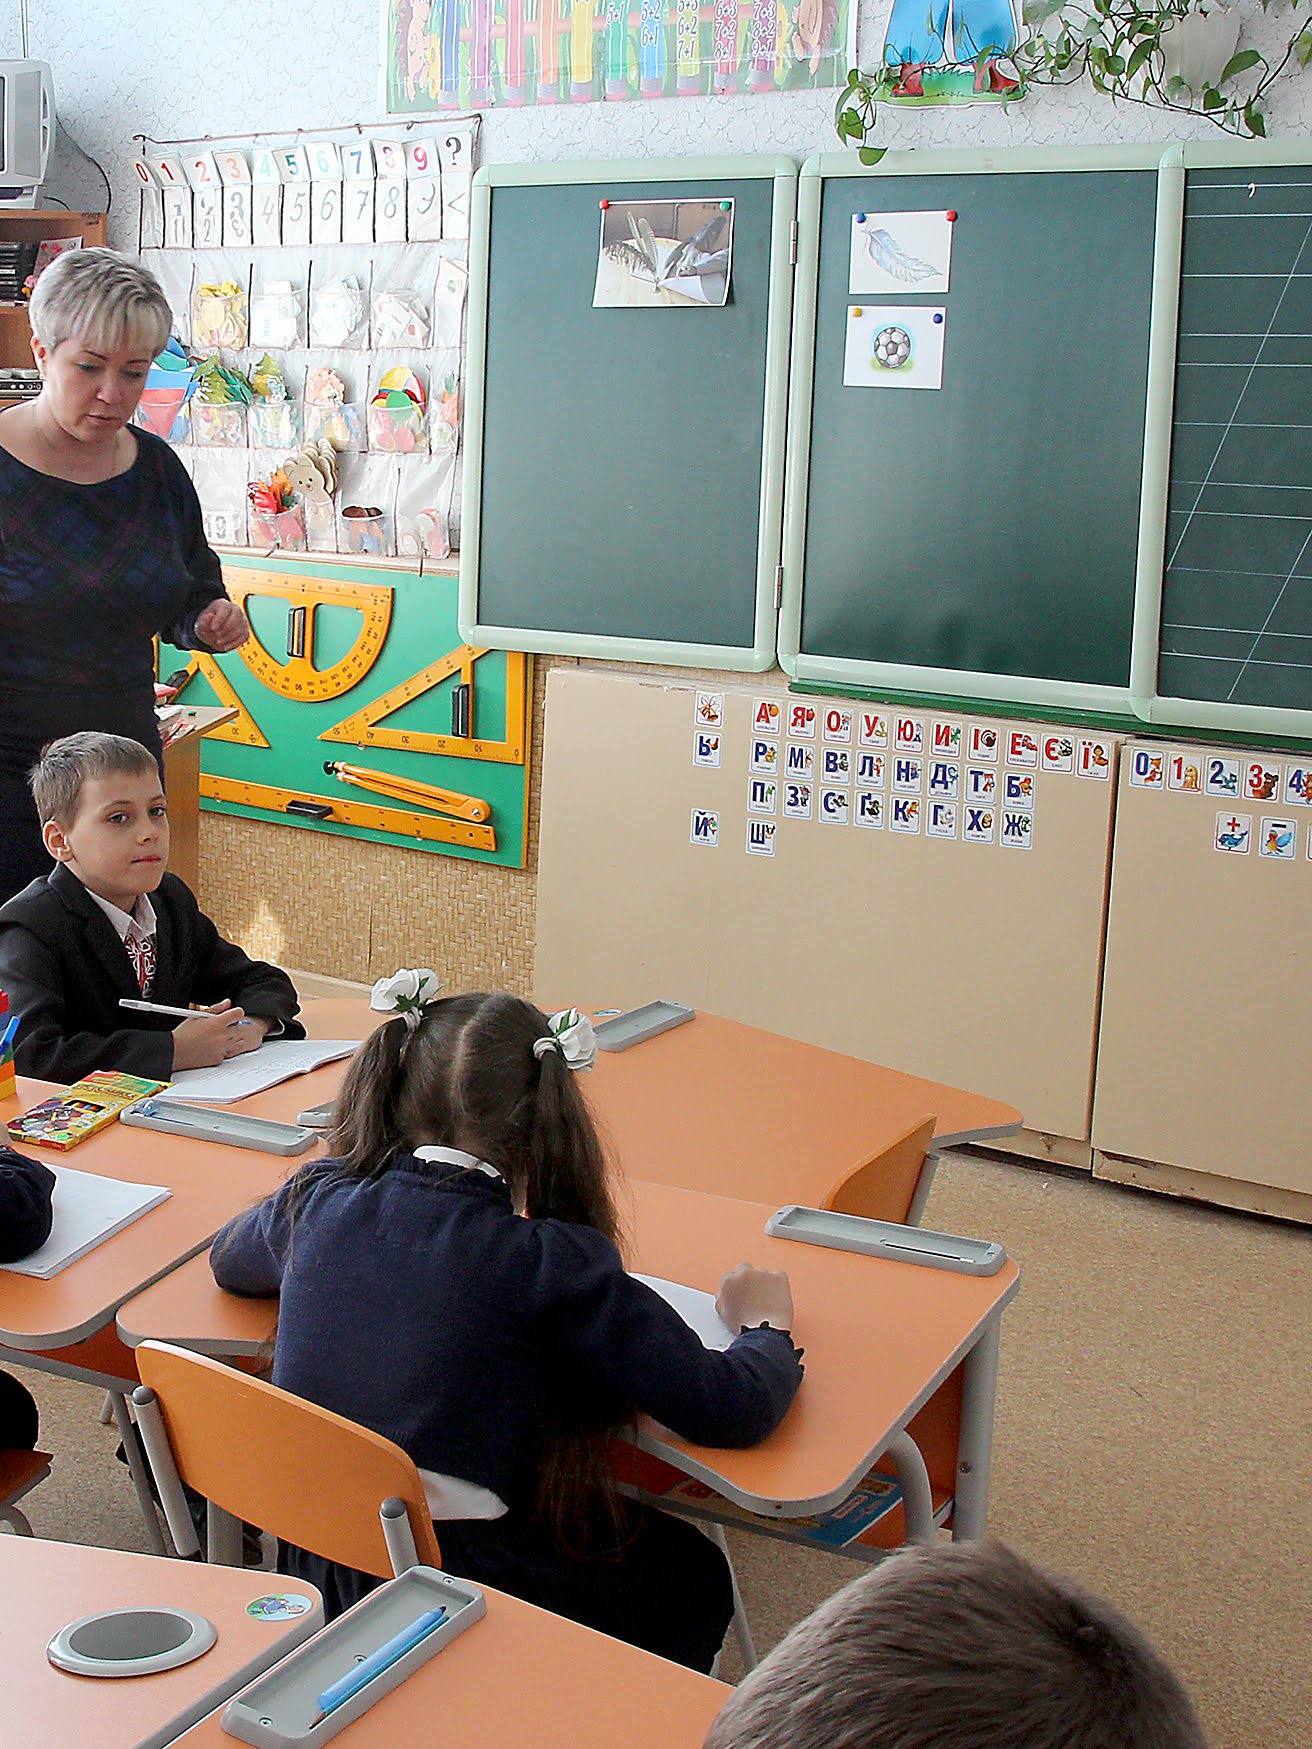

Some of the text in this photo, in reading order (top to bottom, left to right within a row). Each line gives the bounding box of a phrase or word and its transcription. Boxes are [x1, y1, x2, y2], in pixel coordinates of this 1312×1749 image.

[607, 4, 624, 24] 5+1
[641, 0, 660, 20] 5+2
[716, 1, 737, 18] 6+3
[753, 3, 776, 20] 7+3
[642, 26, 659, 46] 6+1
[677, 16, 698, 36] 6+2
[715, 21, 736, 39] 7+2
[753, 21, 775, 39] 8+2
[677, 39, 695, 60] 7+1
[715, 41, 733, 60] 8+1
[752, 39, 773, 57] 9+1
[135, 137, 462, 182] 0 1 2 3 4 5 6 7 8 9 ?
[262, 195, 275, 224] 4
[289, 192, 306, 222] 5
[320, 189, 337, 221] 6
[357, 189, 370, 220] 7
[383, 186, 400, 219] 8
[401, 735, 409, 744] 30
[438, 740, 446, 748] 20
[756, 703, 1093, 770] А Я О У Ю И І Е Є Ї
[699, 736, 1021, 798] Ь Р М В Л Н Д Т Б
[1135, 752, 1303, 793] 0 1 2 3 4
[752, 782, 1024, 837] П З С Ґ К Г Х Ж
[695, 811, 765, 844] Й Ш
